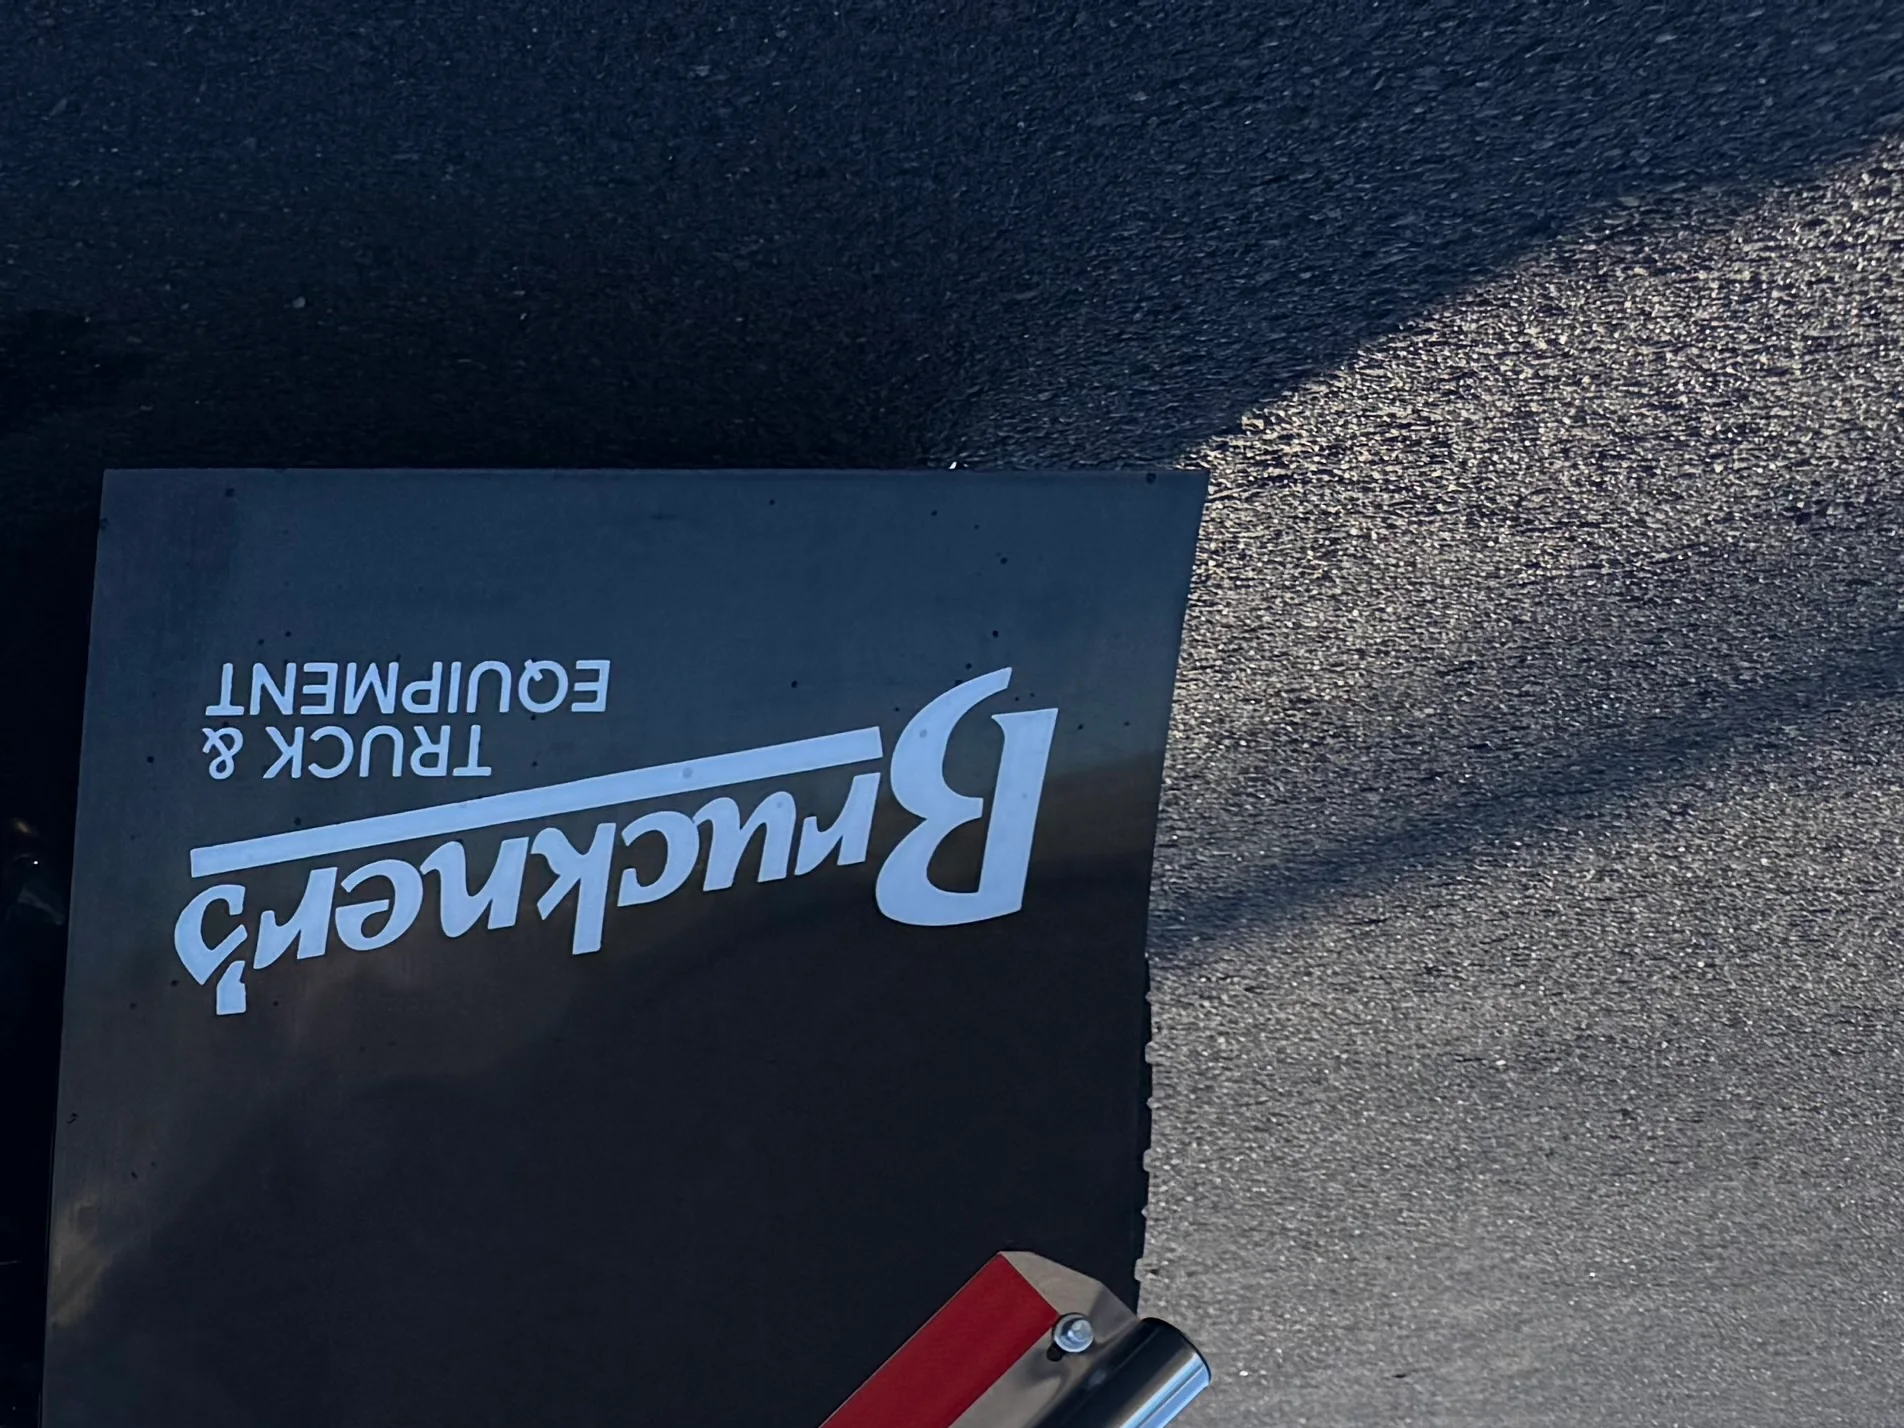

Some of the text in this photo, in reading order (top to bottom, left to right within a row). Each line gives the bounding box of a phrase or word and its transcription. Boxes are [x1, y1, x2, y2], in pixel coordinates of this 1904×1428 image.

[206, 660, 611, 715] EQUIPMENT
[201, 724, 492, 780] TRUCK &
[174, 666, 1059, 1017] Bruckner's
